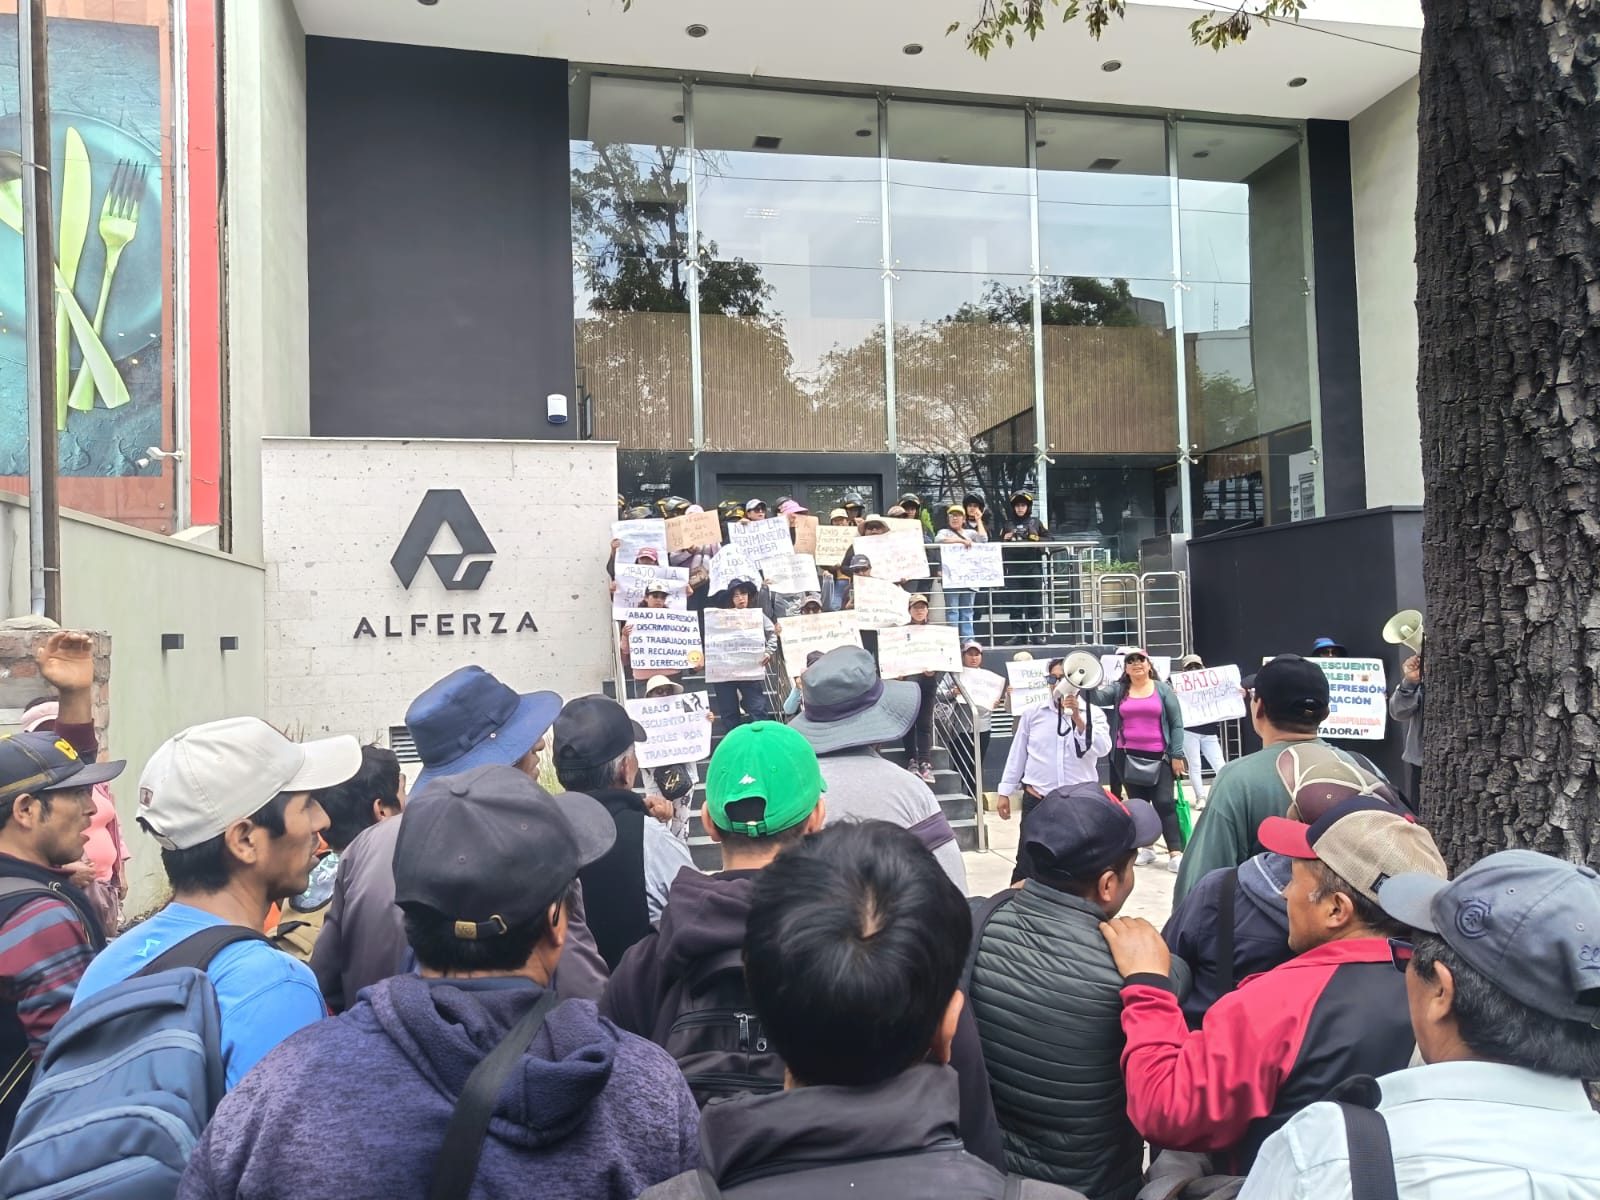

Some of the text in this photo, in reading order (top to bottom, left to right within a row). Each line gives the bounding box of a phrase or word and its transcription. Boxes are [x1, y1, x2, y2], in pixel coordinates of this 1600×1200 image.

[623, 566, 655, 578] ABAJO
[628, 611, 698, 623] ABAJO LA REPRESIÓN
[353, 610, 539, 640] ALFERZA
[636, 623, 690, 633] DISCRIMINACIÓN
[646, 636, 701, 646] TRABAJADORES
[648, 647, 688, 656] RECLAMAR
[650, 659, 689, 667] DERECHOS
[1321, 661, 1380, 672] ESCUENTO
[1175, 669, 1220, 693] ABAJO
[1330, 683, 1386, 694] EPRESIÓN
[1328, 695, 1372, 706] NACIÓN
[641, 703, 670, 715] ABAJO
[640, 715, 686, 729] ESCUENTO
[644, 744, 703, 761] TRABAJADOR
